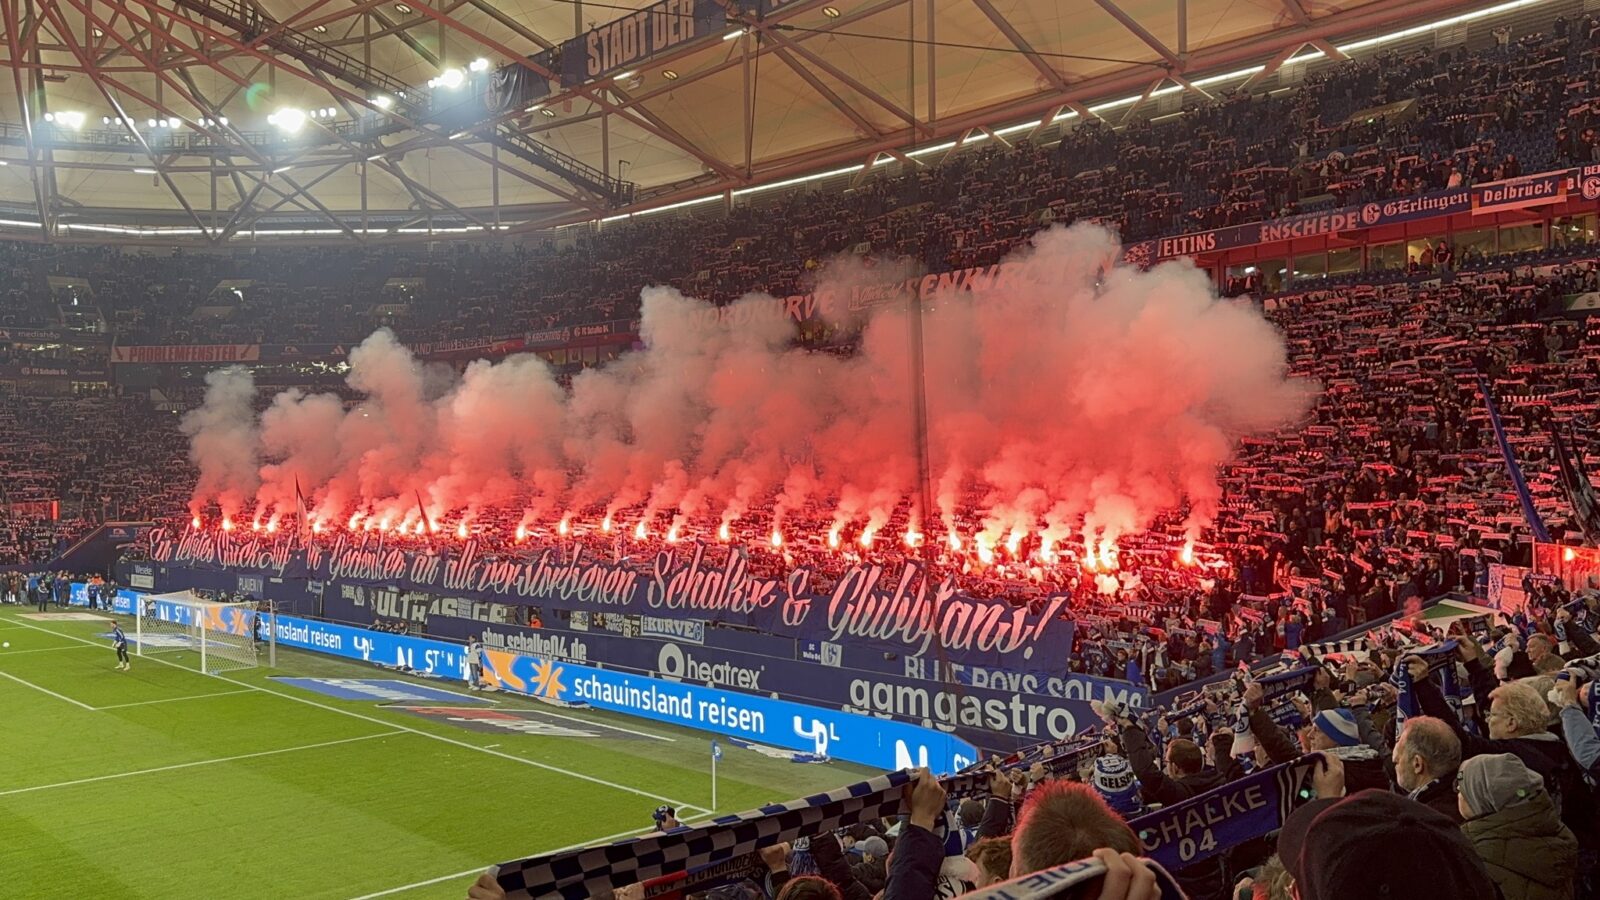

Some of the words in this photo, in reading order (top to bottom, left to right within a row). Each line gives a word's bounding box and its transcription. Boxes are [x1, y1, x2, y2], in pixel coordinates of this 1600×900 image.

[587, 11, 648, 76] STADT
[652, 0, 694, 51] DER
[1484, 181, 1554, 203] Delbrück
[1261, 211, 1358, 242] ENSCHEDE
[129, 345, 237, 362] PROBLEMFENSTER
[149, 526, 172, 562] Ein
[329, 533, 406, 581] Gedenken
[410, 555, 439, 585] an
[443, 540, 482, 591] alle
[477, 542, 638, 606] verstorbenen
[783, 568, 812, 626] &
[311, 626, 342, 650] reisen
[648, 617, 694, 637] KURVE
[482, 627, 587, 664] shop.schalke04.de
[687, 655, 760, 691] heatrex
[574, 675, 692, 720] schauinsland
[698, 697, 764, 734] reisen
[850, 679, 1076, 741] ggmgastro
[1142, 784, 1267, 852] CHALKE
[1179, 828, 1218, 862] 04
